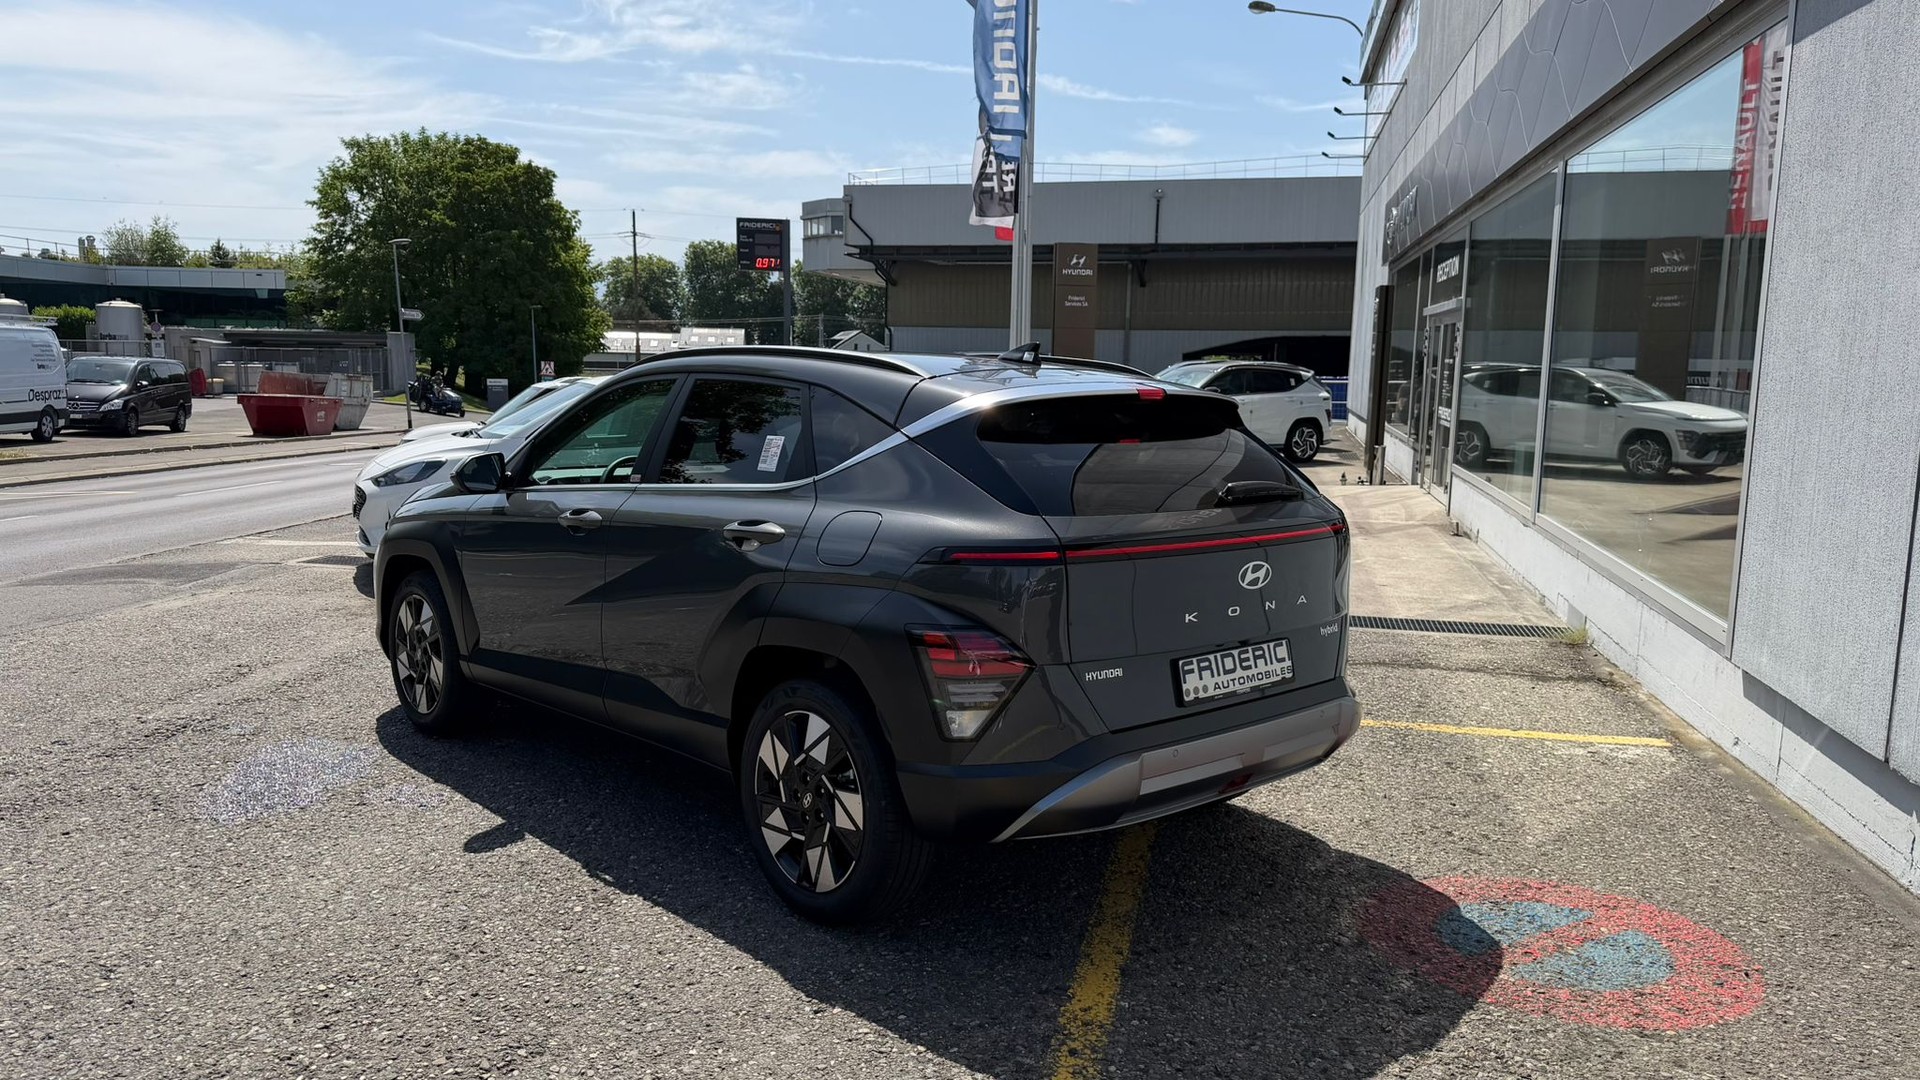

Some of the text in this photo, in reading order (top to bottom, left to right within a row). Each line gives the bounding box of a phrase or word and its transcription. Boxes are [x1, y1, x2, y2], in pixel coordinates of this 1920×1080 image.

[28, 389, 61, 403] Despraz
[1185, 595, 1307, 623] KONA
[1320, 622, 1339, 636] hybrid
[1180, 640, 1292, 685] FRIDERICI
[1085, 667, 1123, 682] HYUNDAI
[1213, 665, 1293, 692] AUTOMOBILES
